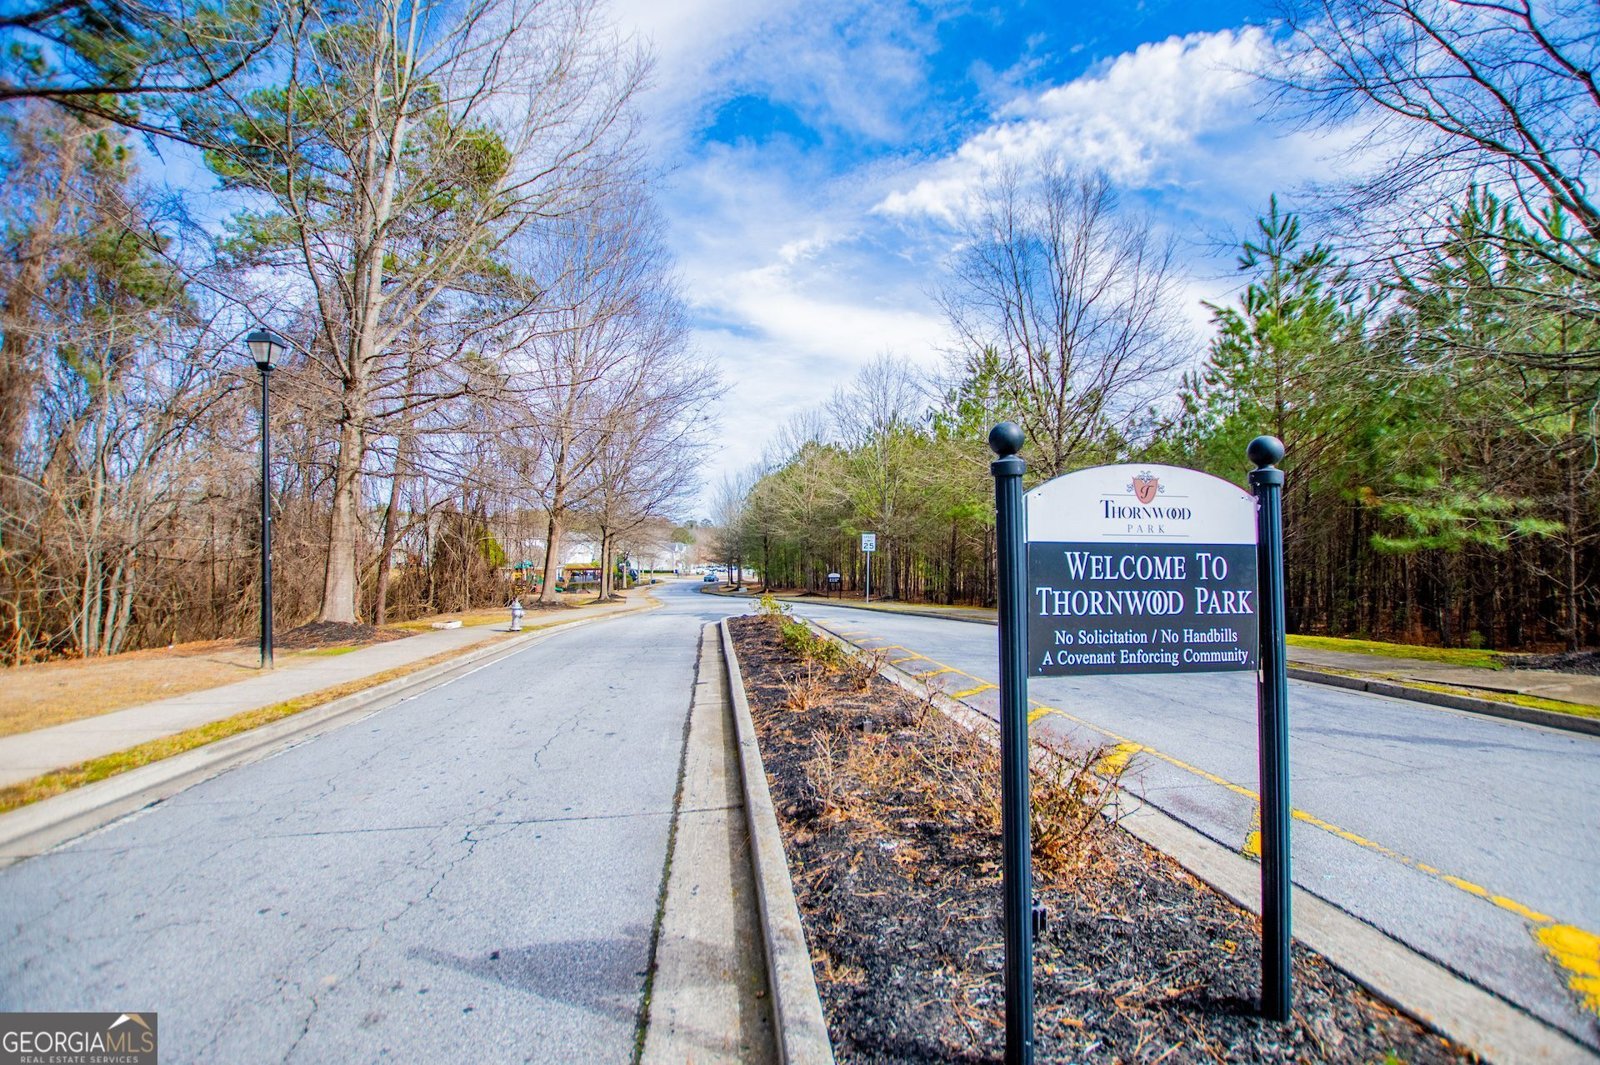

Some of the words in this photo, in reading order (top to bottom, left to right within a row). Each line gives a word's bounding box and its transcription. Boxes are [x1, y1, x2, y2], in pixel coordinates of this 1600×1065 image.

[1100, 500, 1191, 520] THORNWOOD
[1128, 524, 1165, 534] PARK
[863, 542, 875, 550] 25
[1064, 552, 1186, 581] WELCOME
[1196, 553, 1228, 581] TO
[1036, 587, 1184, 616] THORNWOOD
[1195, 588, 1253, 614] PARK
[1055, 630, 1073, 644] No
[1078, 629, 1148, 644] Solicitation
[1152, 629, 1157, 643] /
[1161, 629, 1179, 643] No
[1184, 628, 1238, 642] Handbills
[1042, 652, 1054, 666] A
[1058, 650, 1116, 665] Covenant
[1120, 649, 1179, 666] Enforcing
[1184, 648, 1248, 665] Community
